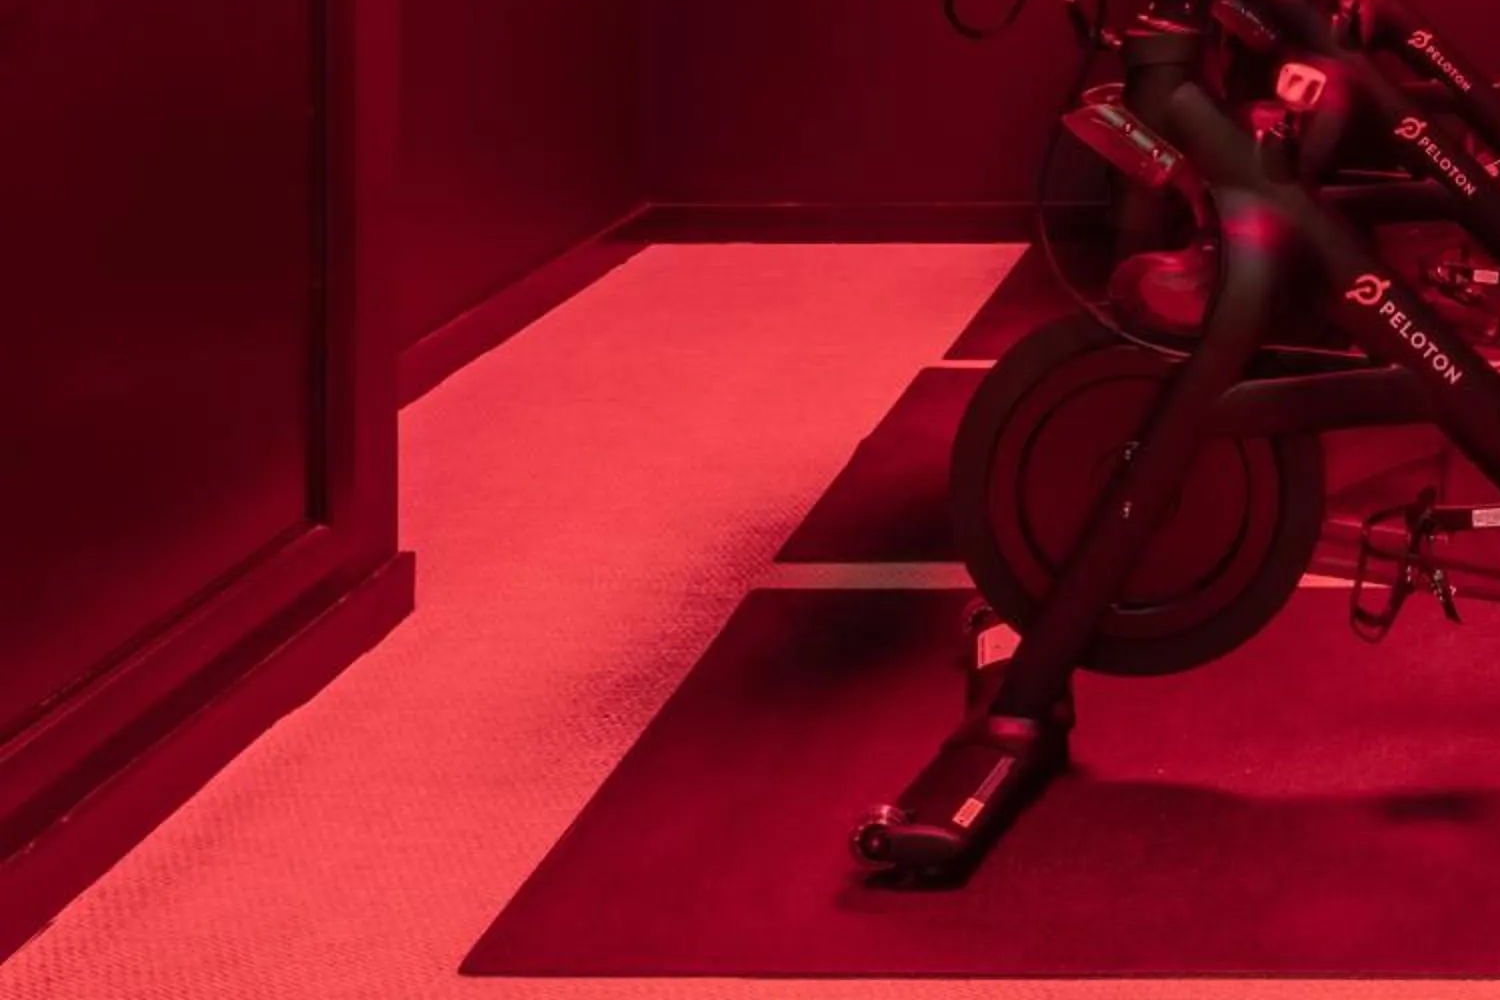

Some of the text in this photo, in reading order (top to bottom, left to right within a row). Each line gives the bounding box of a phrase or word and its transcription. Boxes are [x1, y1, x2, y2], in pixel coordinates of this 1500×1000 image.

[1425, 46, 1472, 91] PELOTON
[1418, 137, 1476, 195] PELOTON
[1380, 301, 1462, 384] PELOTON
